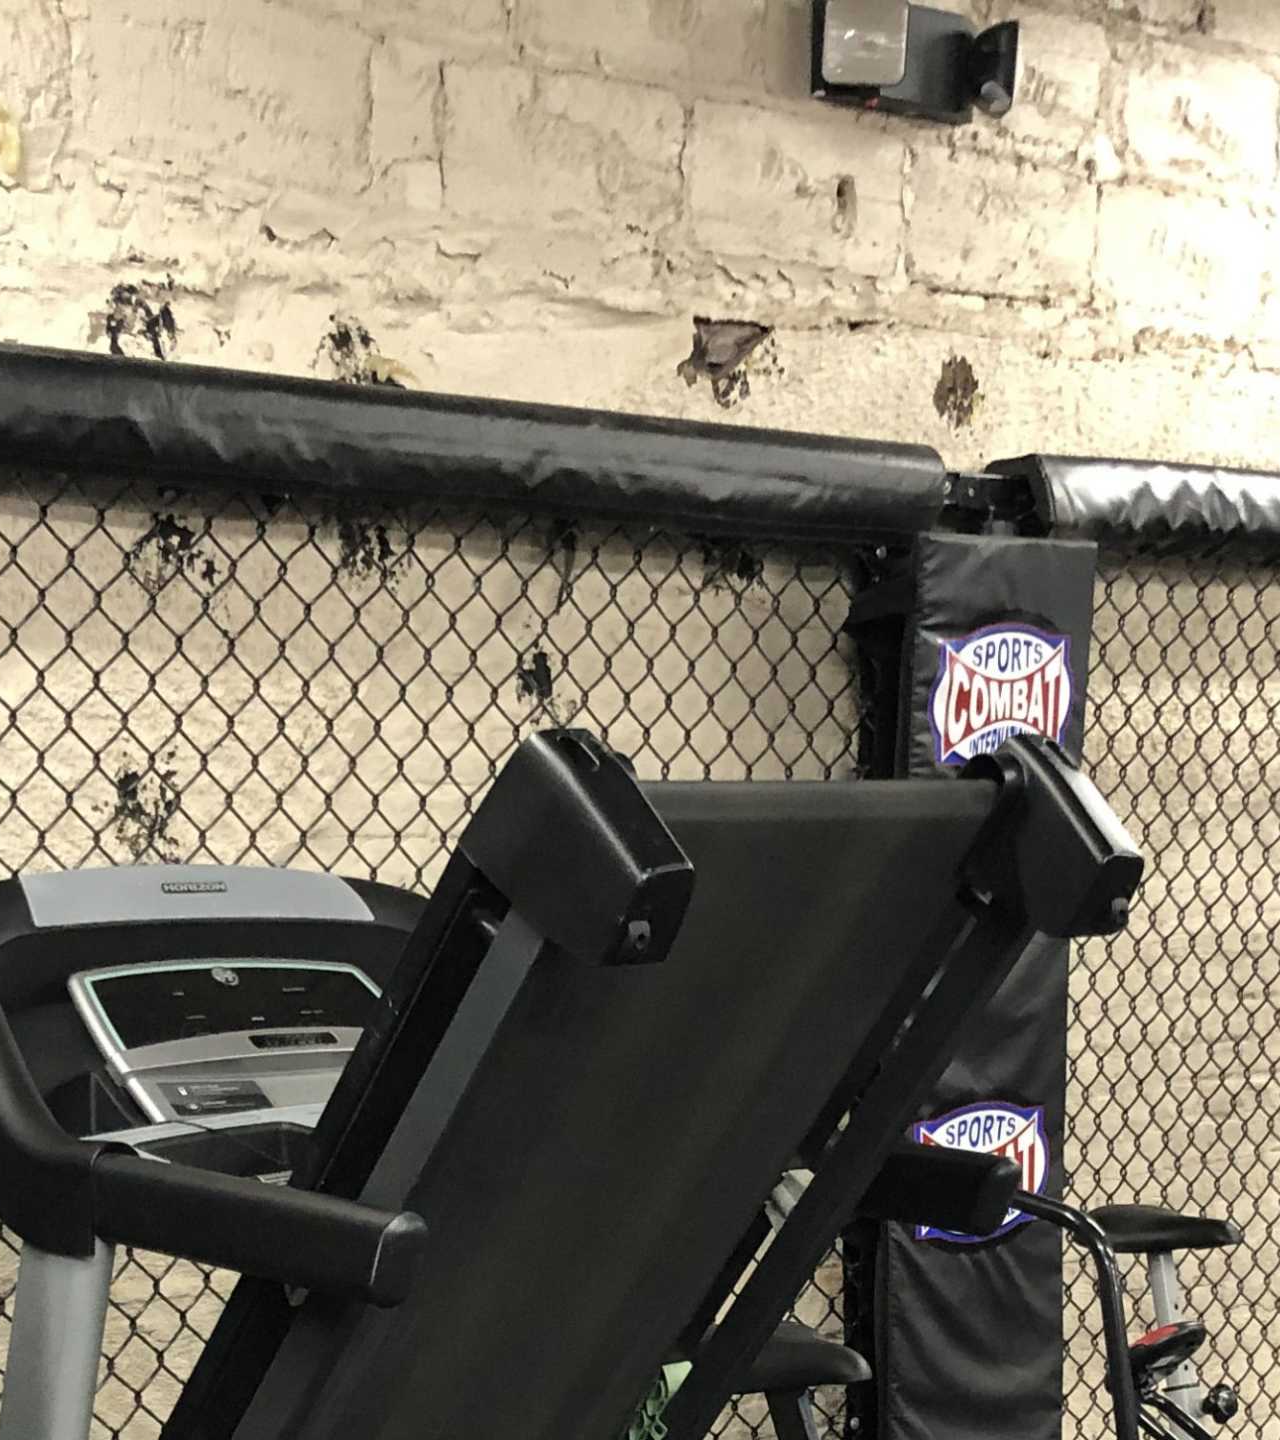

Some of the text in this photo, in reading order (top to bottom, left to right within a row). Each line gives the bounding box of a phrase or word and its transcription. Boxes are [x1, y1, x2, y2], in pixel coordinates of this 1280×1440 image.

[972, 637, 1043, 673] SPORTS
[947, 653, 1063, 746] COMBAT
[163, 882, 225, 893] HORIZON
[945, 1114, 1016, 1148] SPORTS
